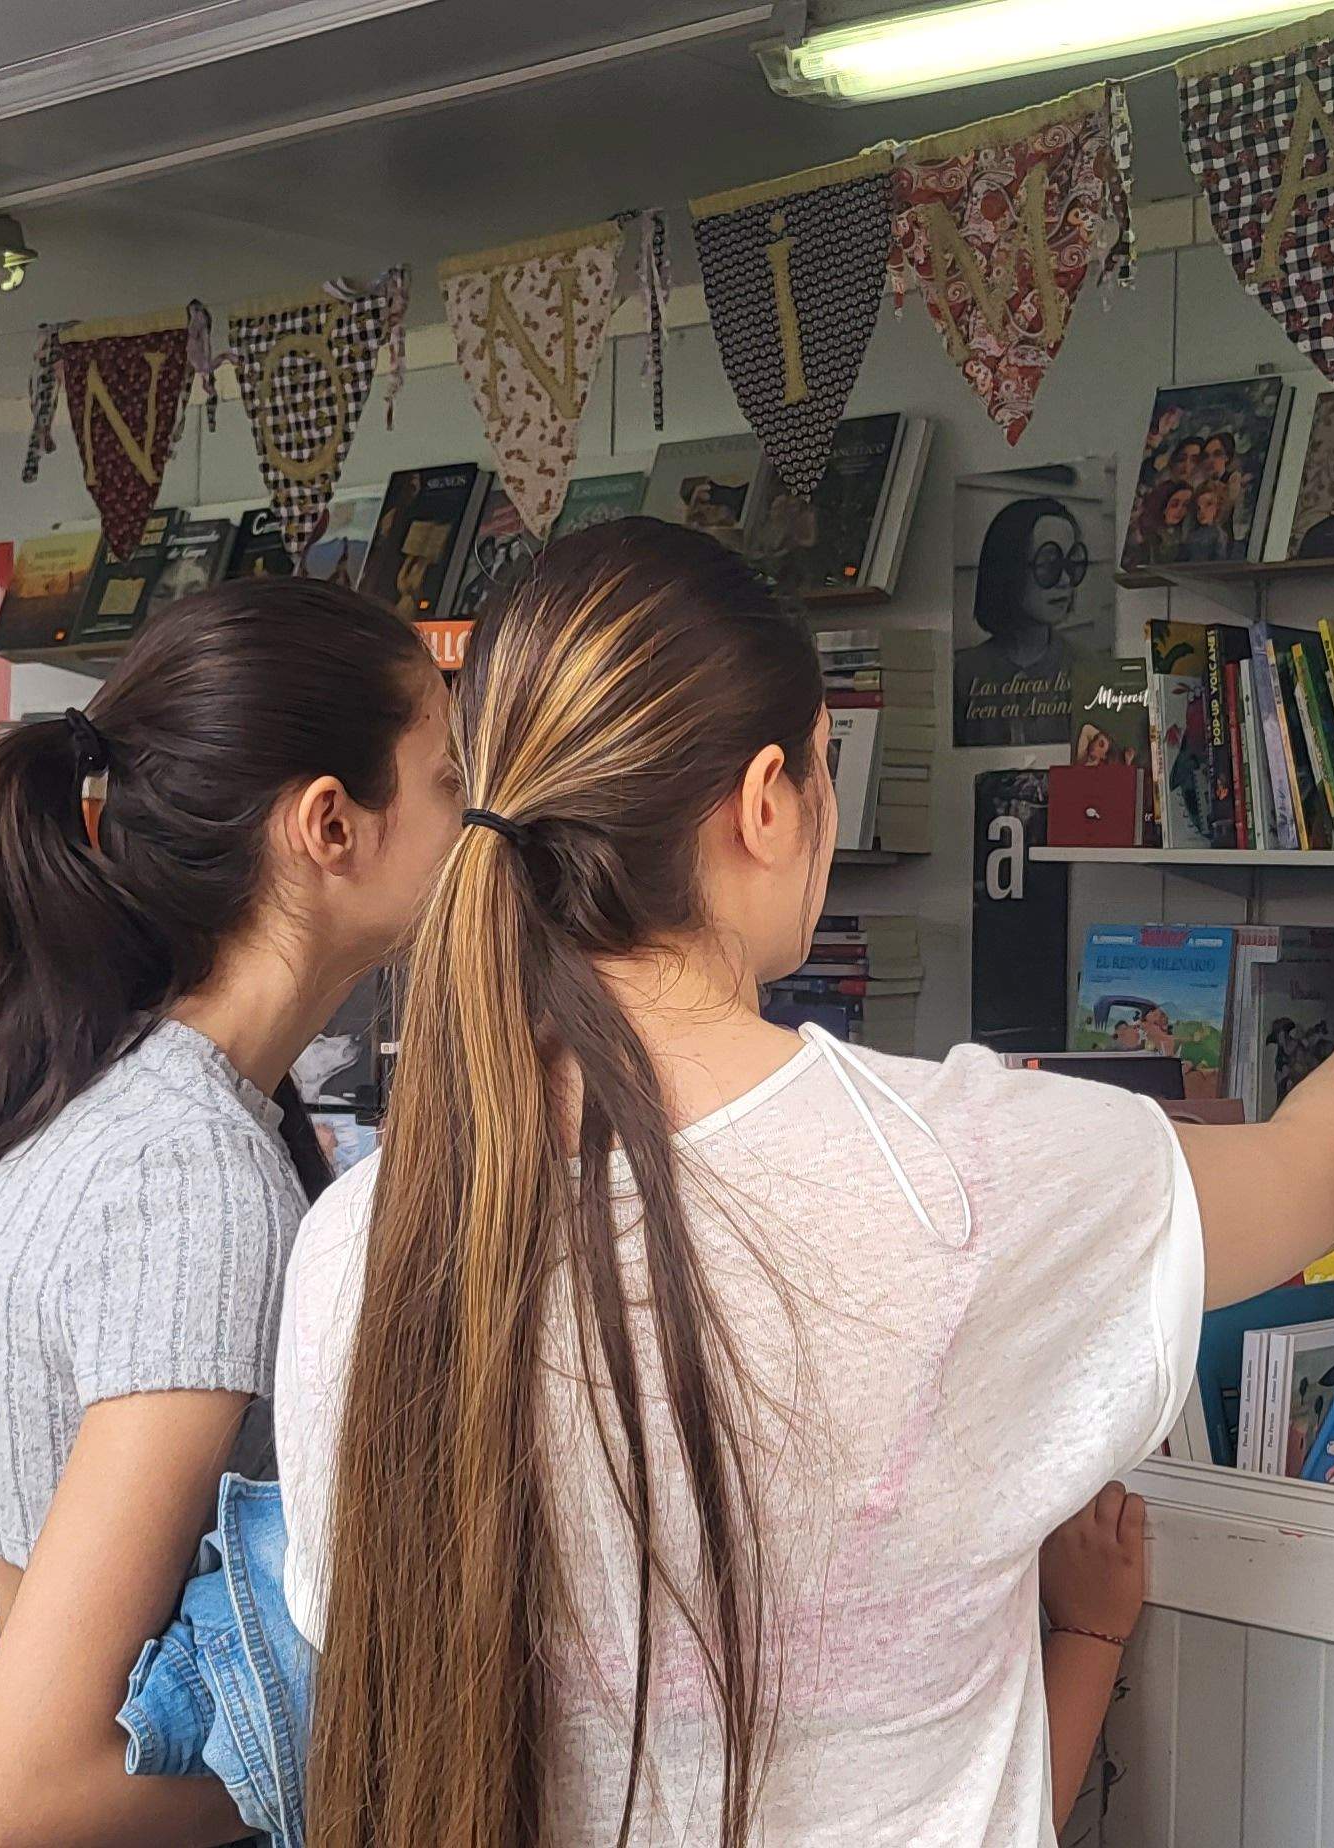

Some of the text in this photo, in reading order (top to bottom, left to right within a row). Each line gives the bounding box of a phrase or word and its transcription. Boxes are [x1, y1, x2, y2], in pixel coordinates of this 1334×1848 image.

[969, 677, 997, 695] Las
[1002, 672, 1050, 695] chicas
[966, 701, 1019, 720] leen en
[986, 815, 1024, 900] a
